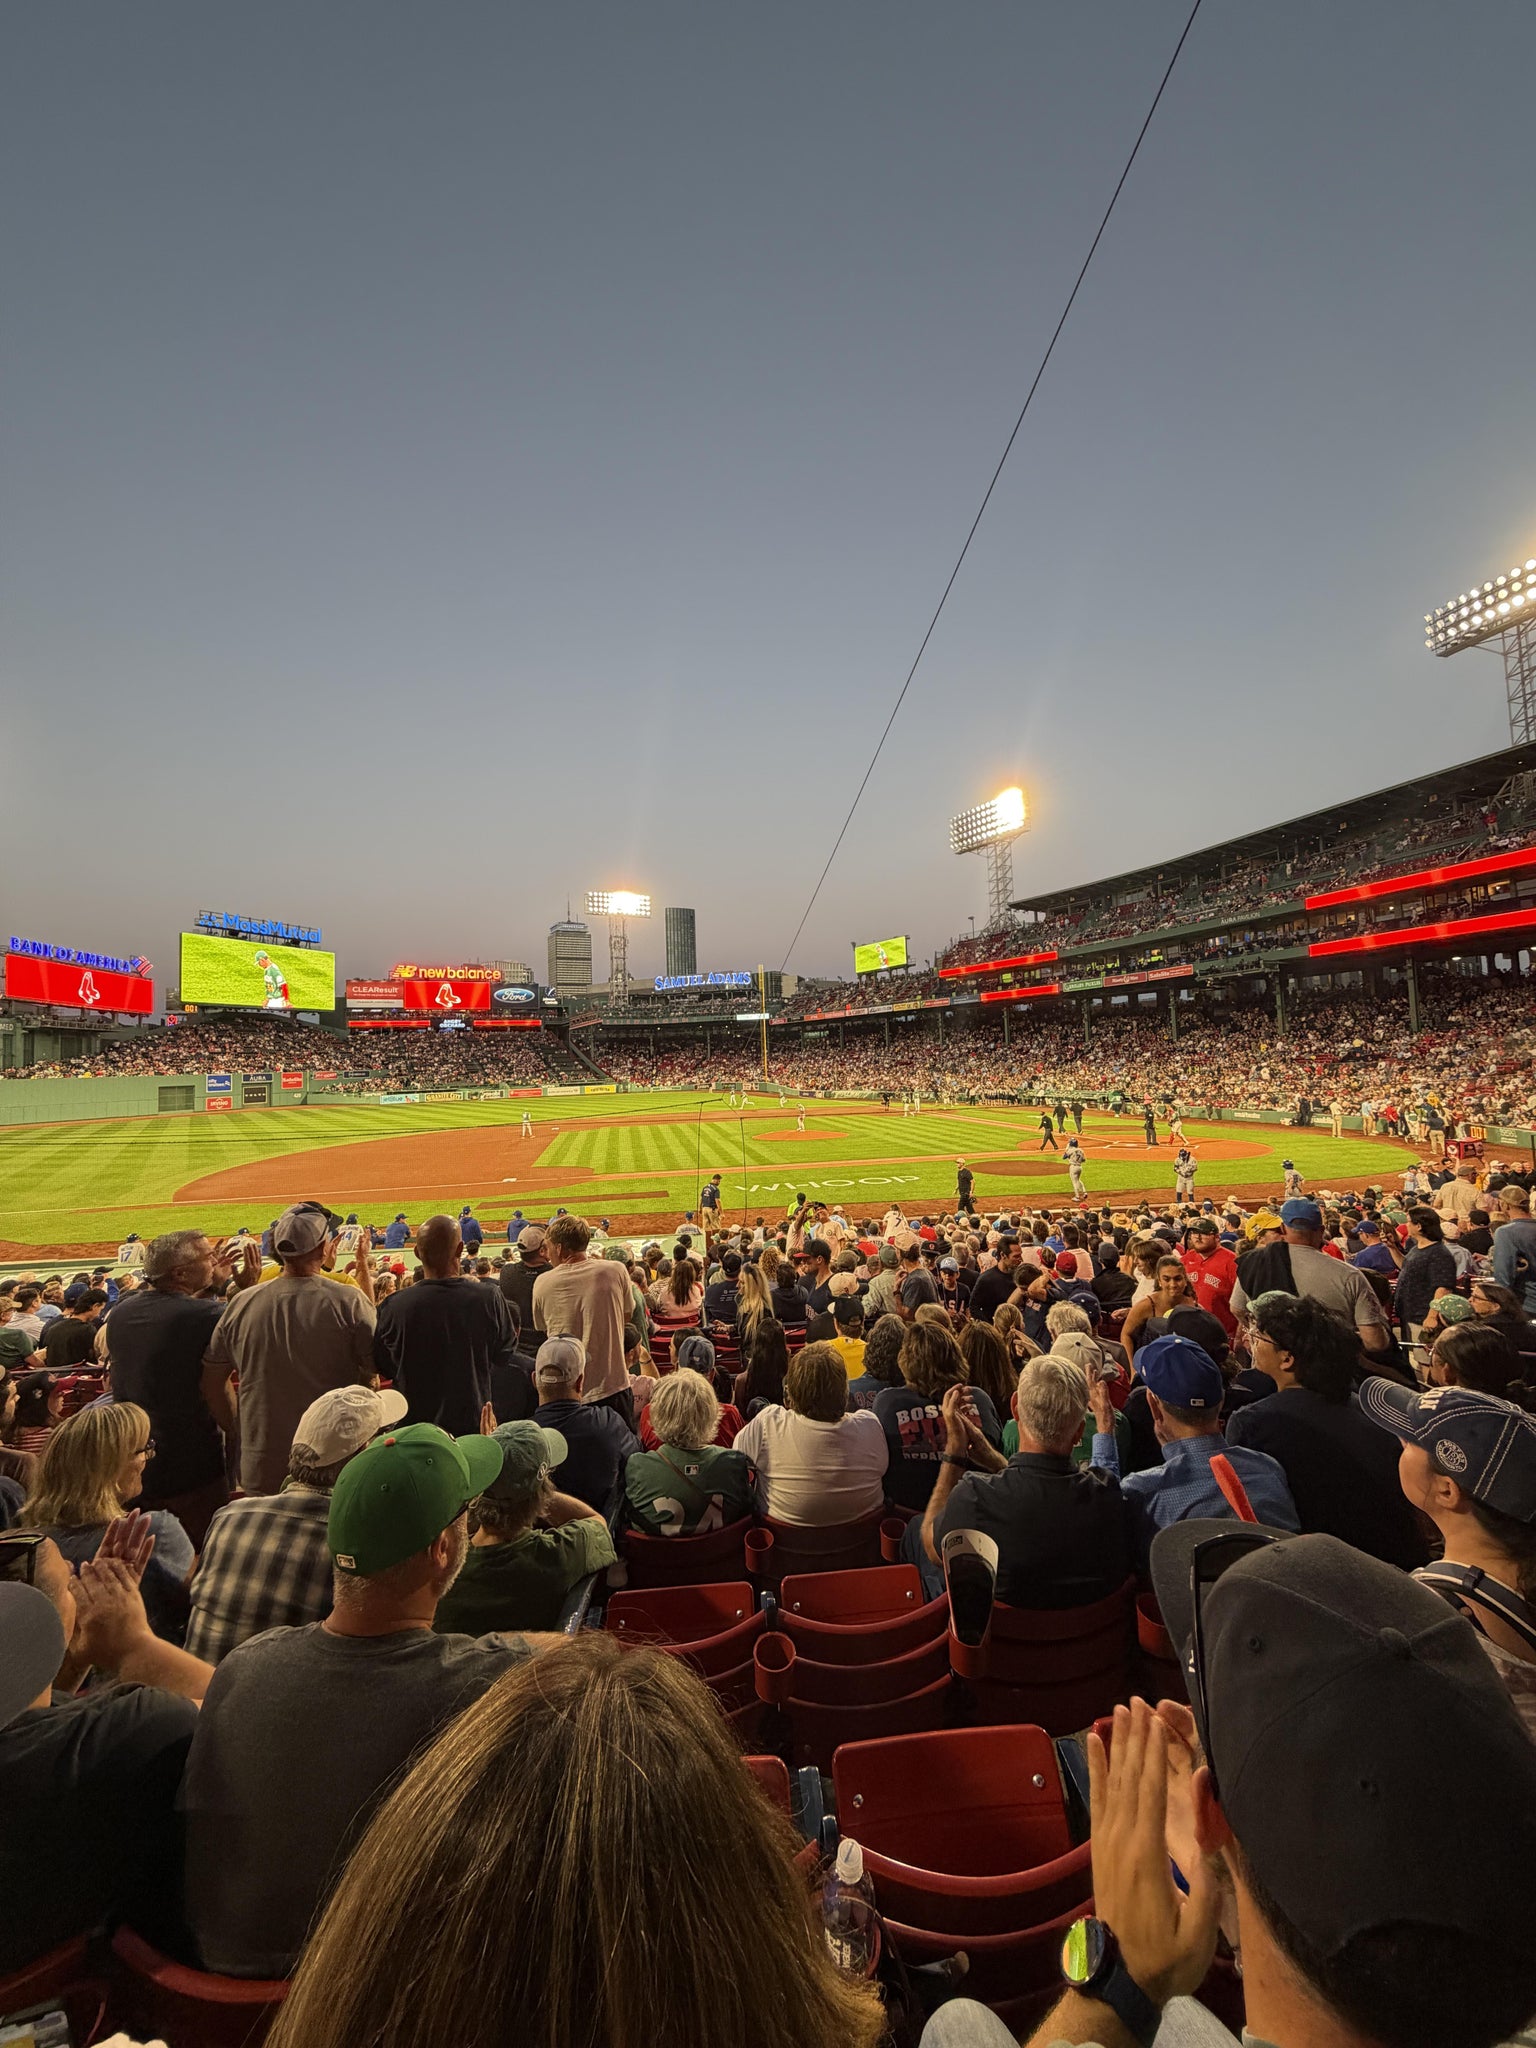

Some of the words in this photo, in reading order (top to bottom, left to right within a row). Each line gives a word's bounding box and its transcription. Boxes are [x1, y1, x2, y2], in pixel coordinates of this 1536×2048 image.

[222, 912, 321, 943] MassMutual
[10, 935, 54, 958] BANK
[56, 946, 74, 961] OF
[76, 950, 131, 973] AMERICA
[419, 967, 449, 980] new
[450, 966, 502, 980] balance
[655, 974, 706, 990] SAMUEL
[706, 972, 752, 985] ADAMS
[352, 986, 400, 994] CLEAResult
[502, 990, 527, 1001] Ford
[734, 1175, 921, 1192] WHOOP
[895, 1217, 902, 1228] 7
[120, 1251, 132, 1262] 17
